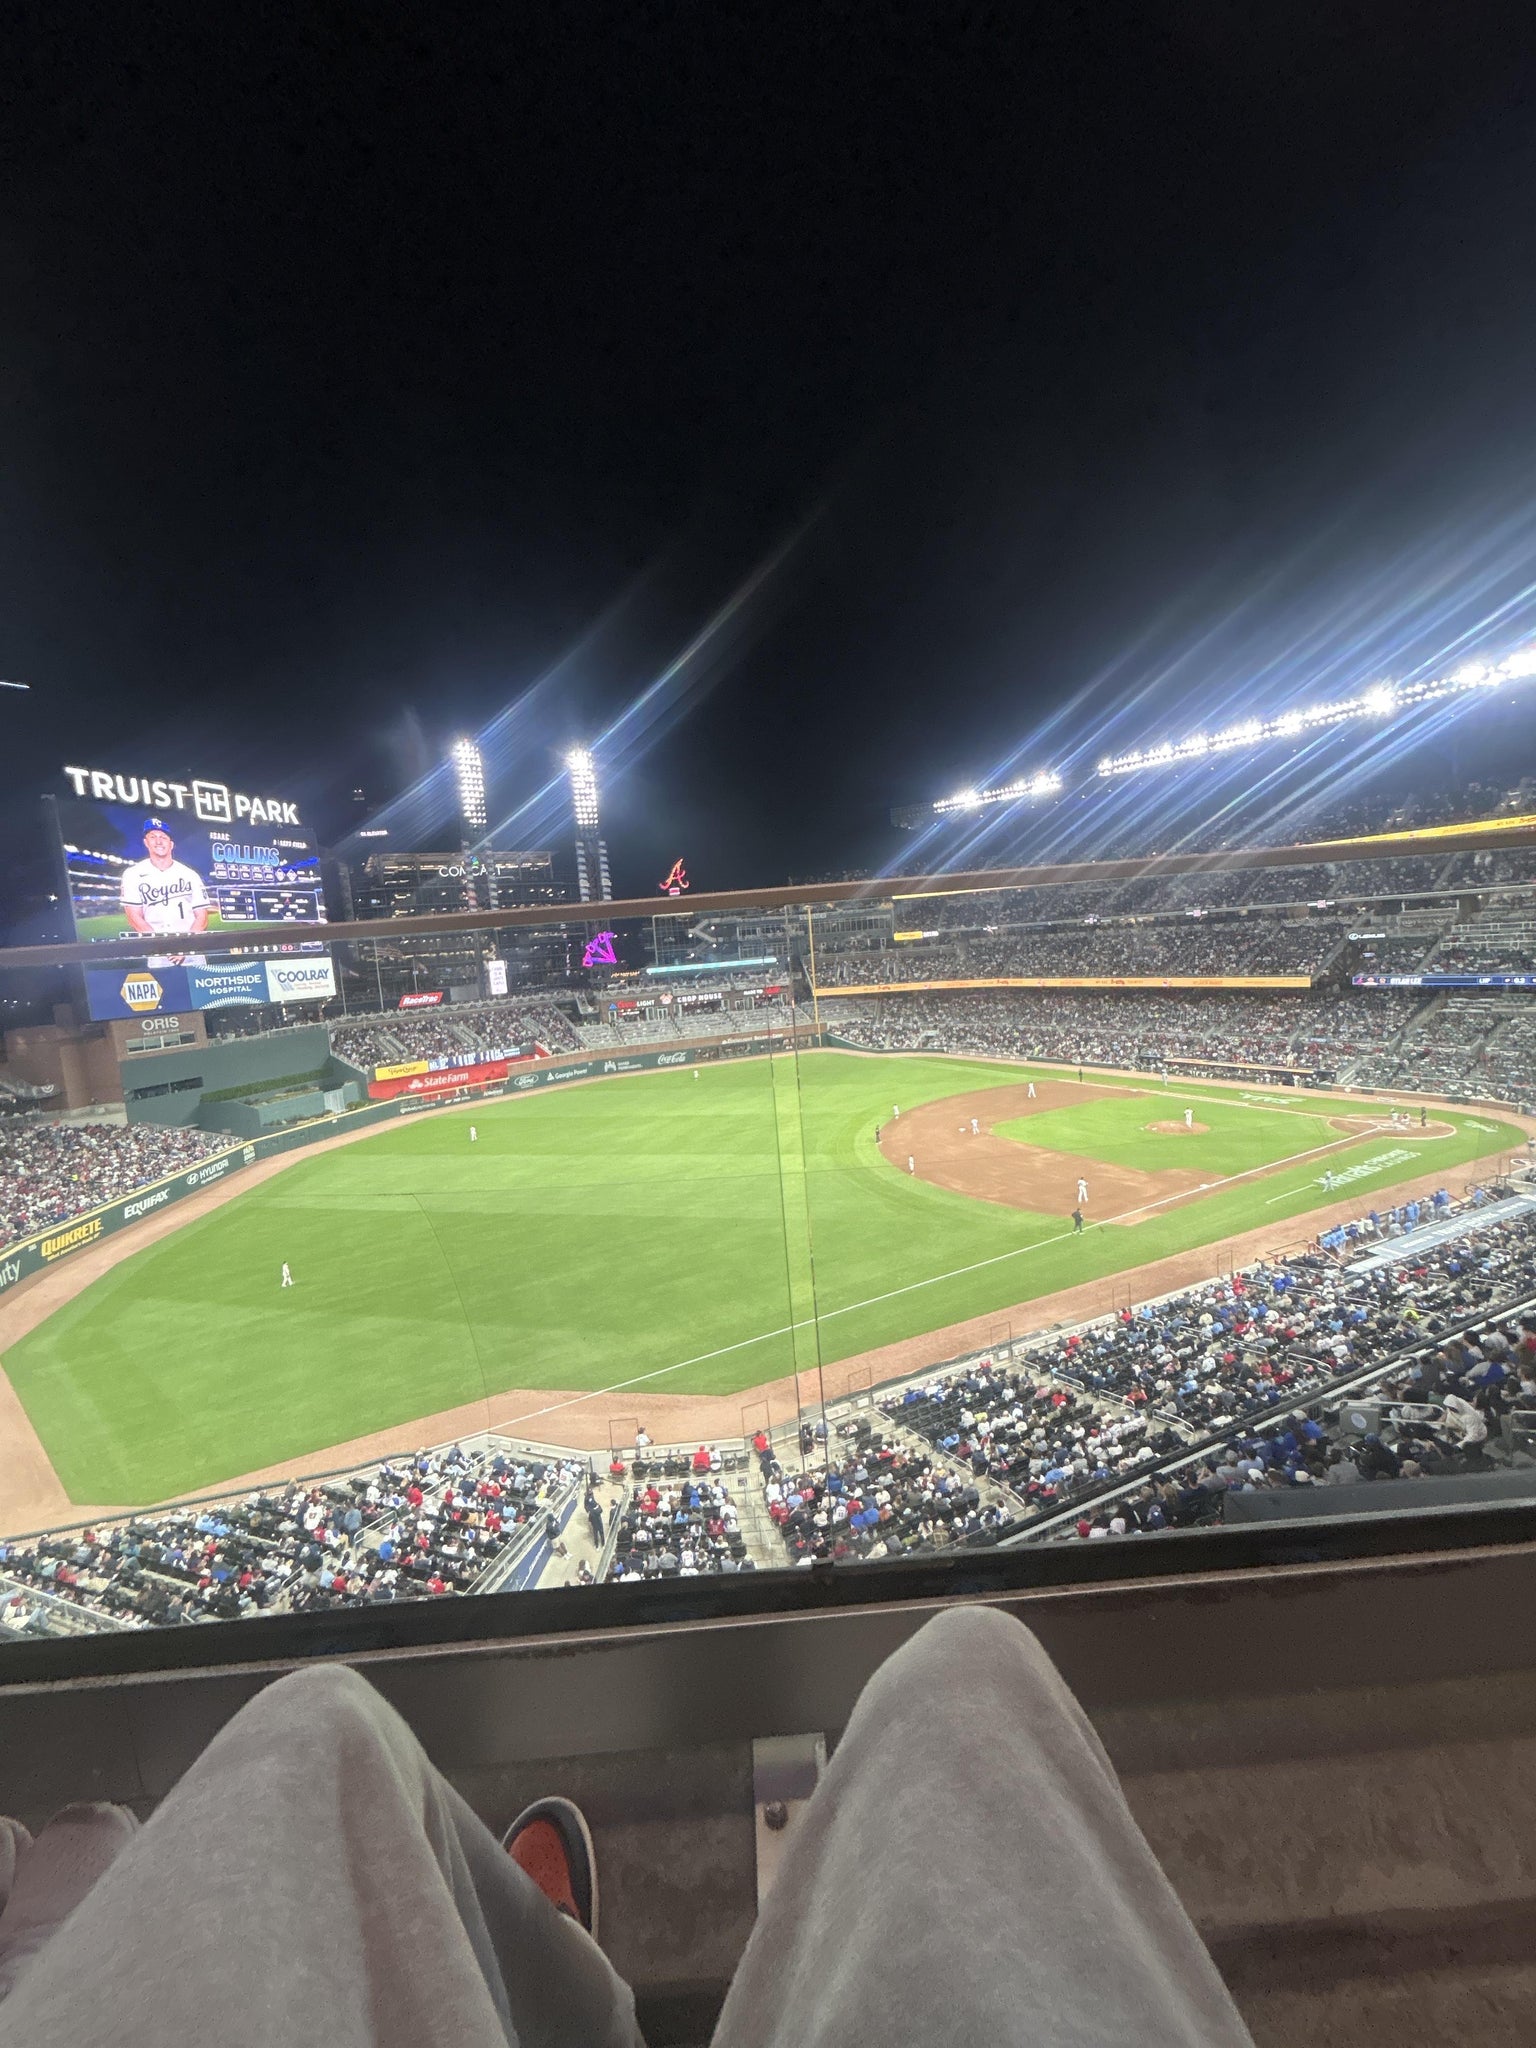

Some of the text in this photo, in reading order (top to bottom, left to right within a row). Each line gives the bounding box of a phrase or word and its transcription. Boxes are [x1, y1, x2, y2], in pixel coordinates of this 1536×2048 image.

[64, 765, 301, 825] TRUIST PARK
[212, 842, 280, 867] COLLINS
[439, 865, 502, 878] COMCAT
[138, 878, 193, 906] Royals
[178, 901, 185, 920] 1
[195, 975, 262, 988] NORTHSIDE
[277, 968, 330, 984] COOLRAY
[127, 983, 158, 1001] NAPA
[209, 985, 252, 995] HOSPITAL
[636, 999, 655, 1007] LIGHT
[141, 1016, 180, 1031] ORIS
[554, 1068, 588, 1080] Georgia Power
[199, 1158, 230, 1180] HYUNDAI
[124, 1188, 170, 1219] EQUIFAX
[41, 1217, 102, 1257] QUIKRETE
